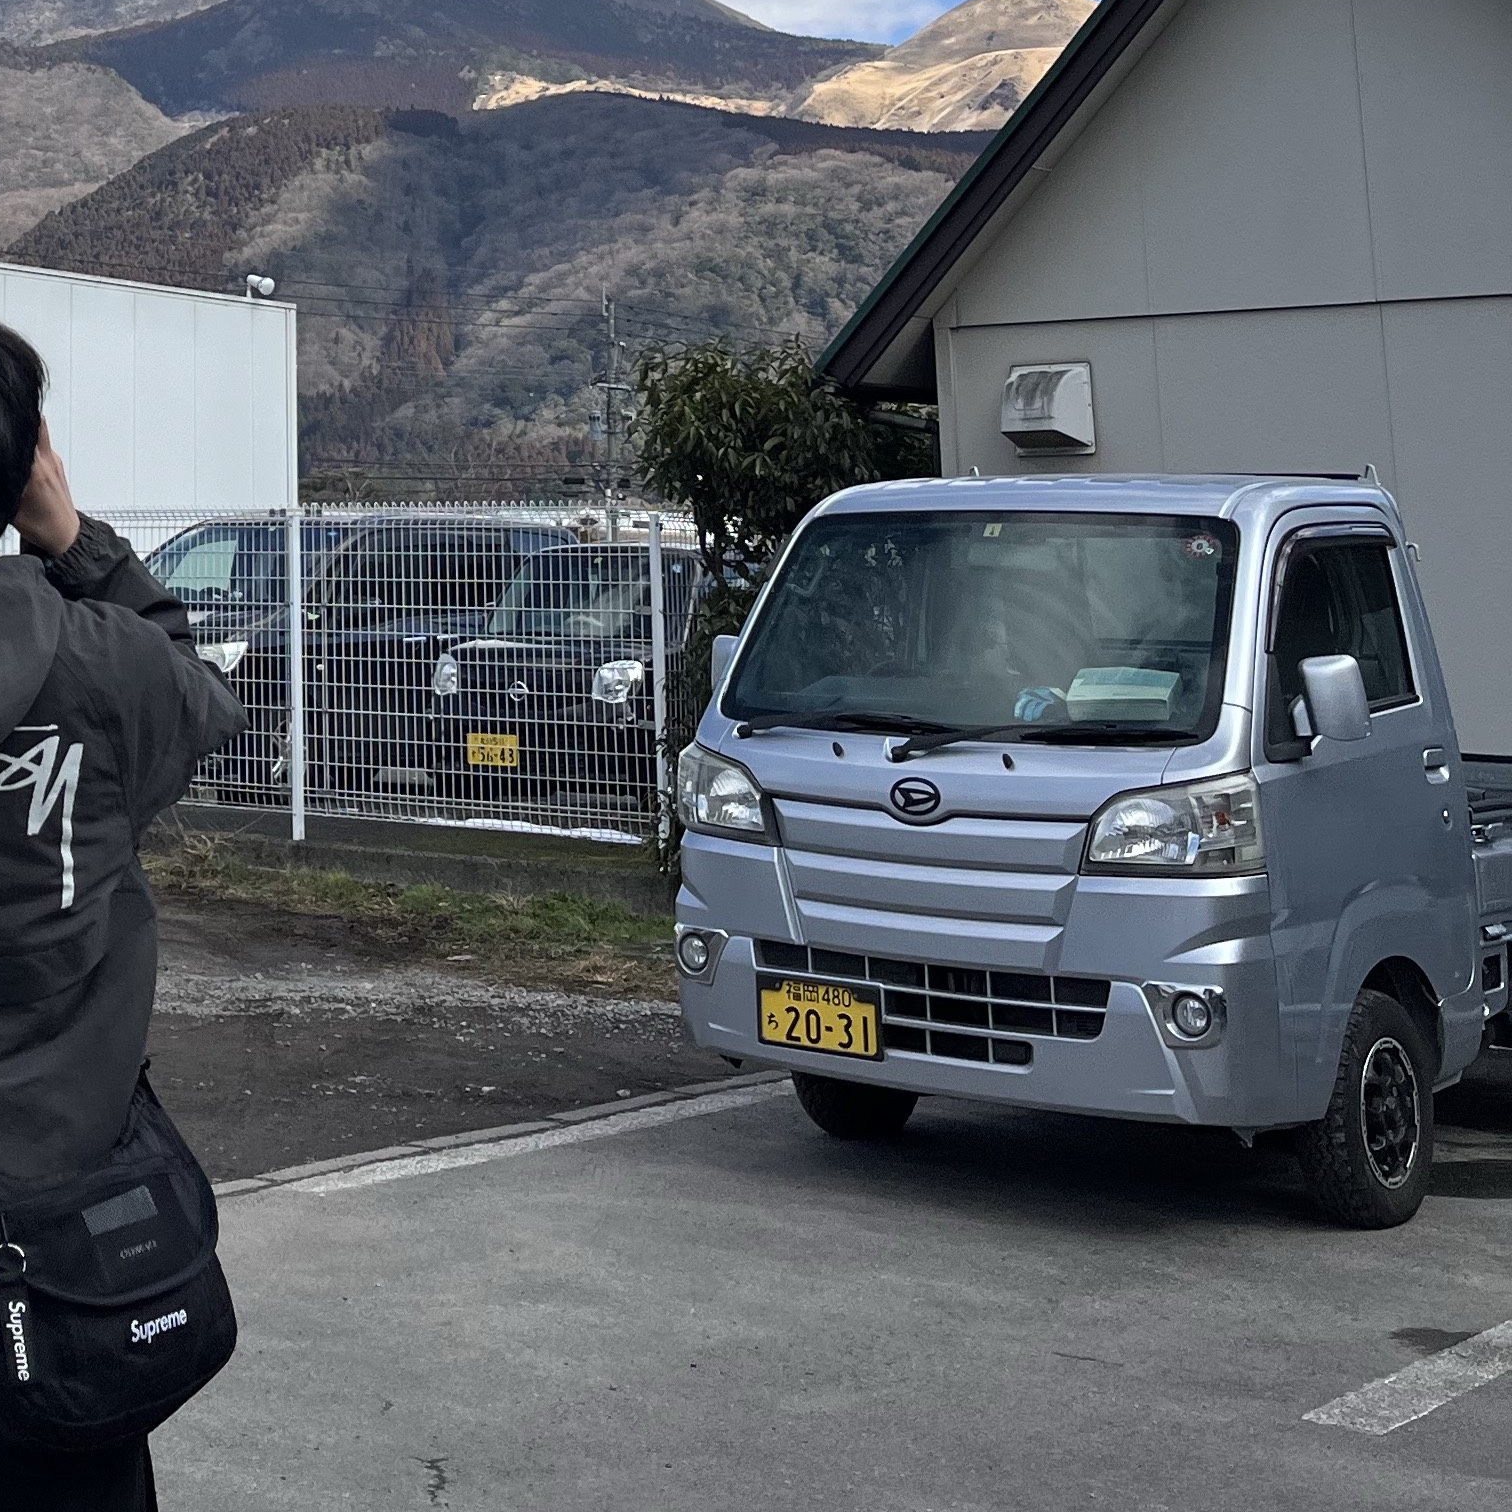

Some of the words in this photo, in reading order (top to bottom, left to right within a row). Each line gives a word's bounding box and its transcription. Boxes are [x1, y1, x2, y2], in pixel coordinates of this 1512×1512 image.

[785, 1006, 869, 1053] 20-31
[6, 1301, 30, 1381] Supreme
[130, 1308, 187, 1344] Supreme
